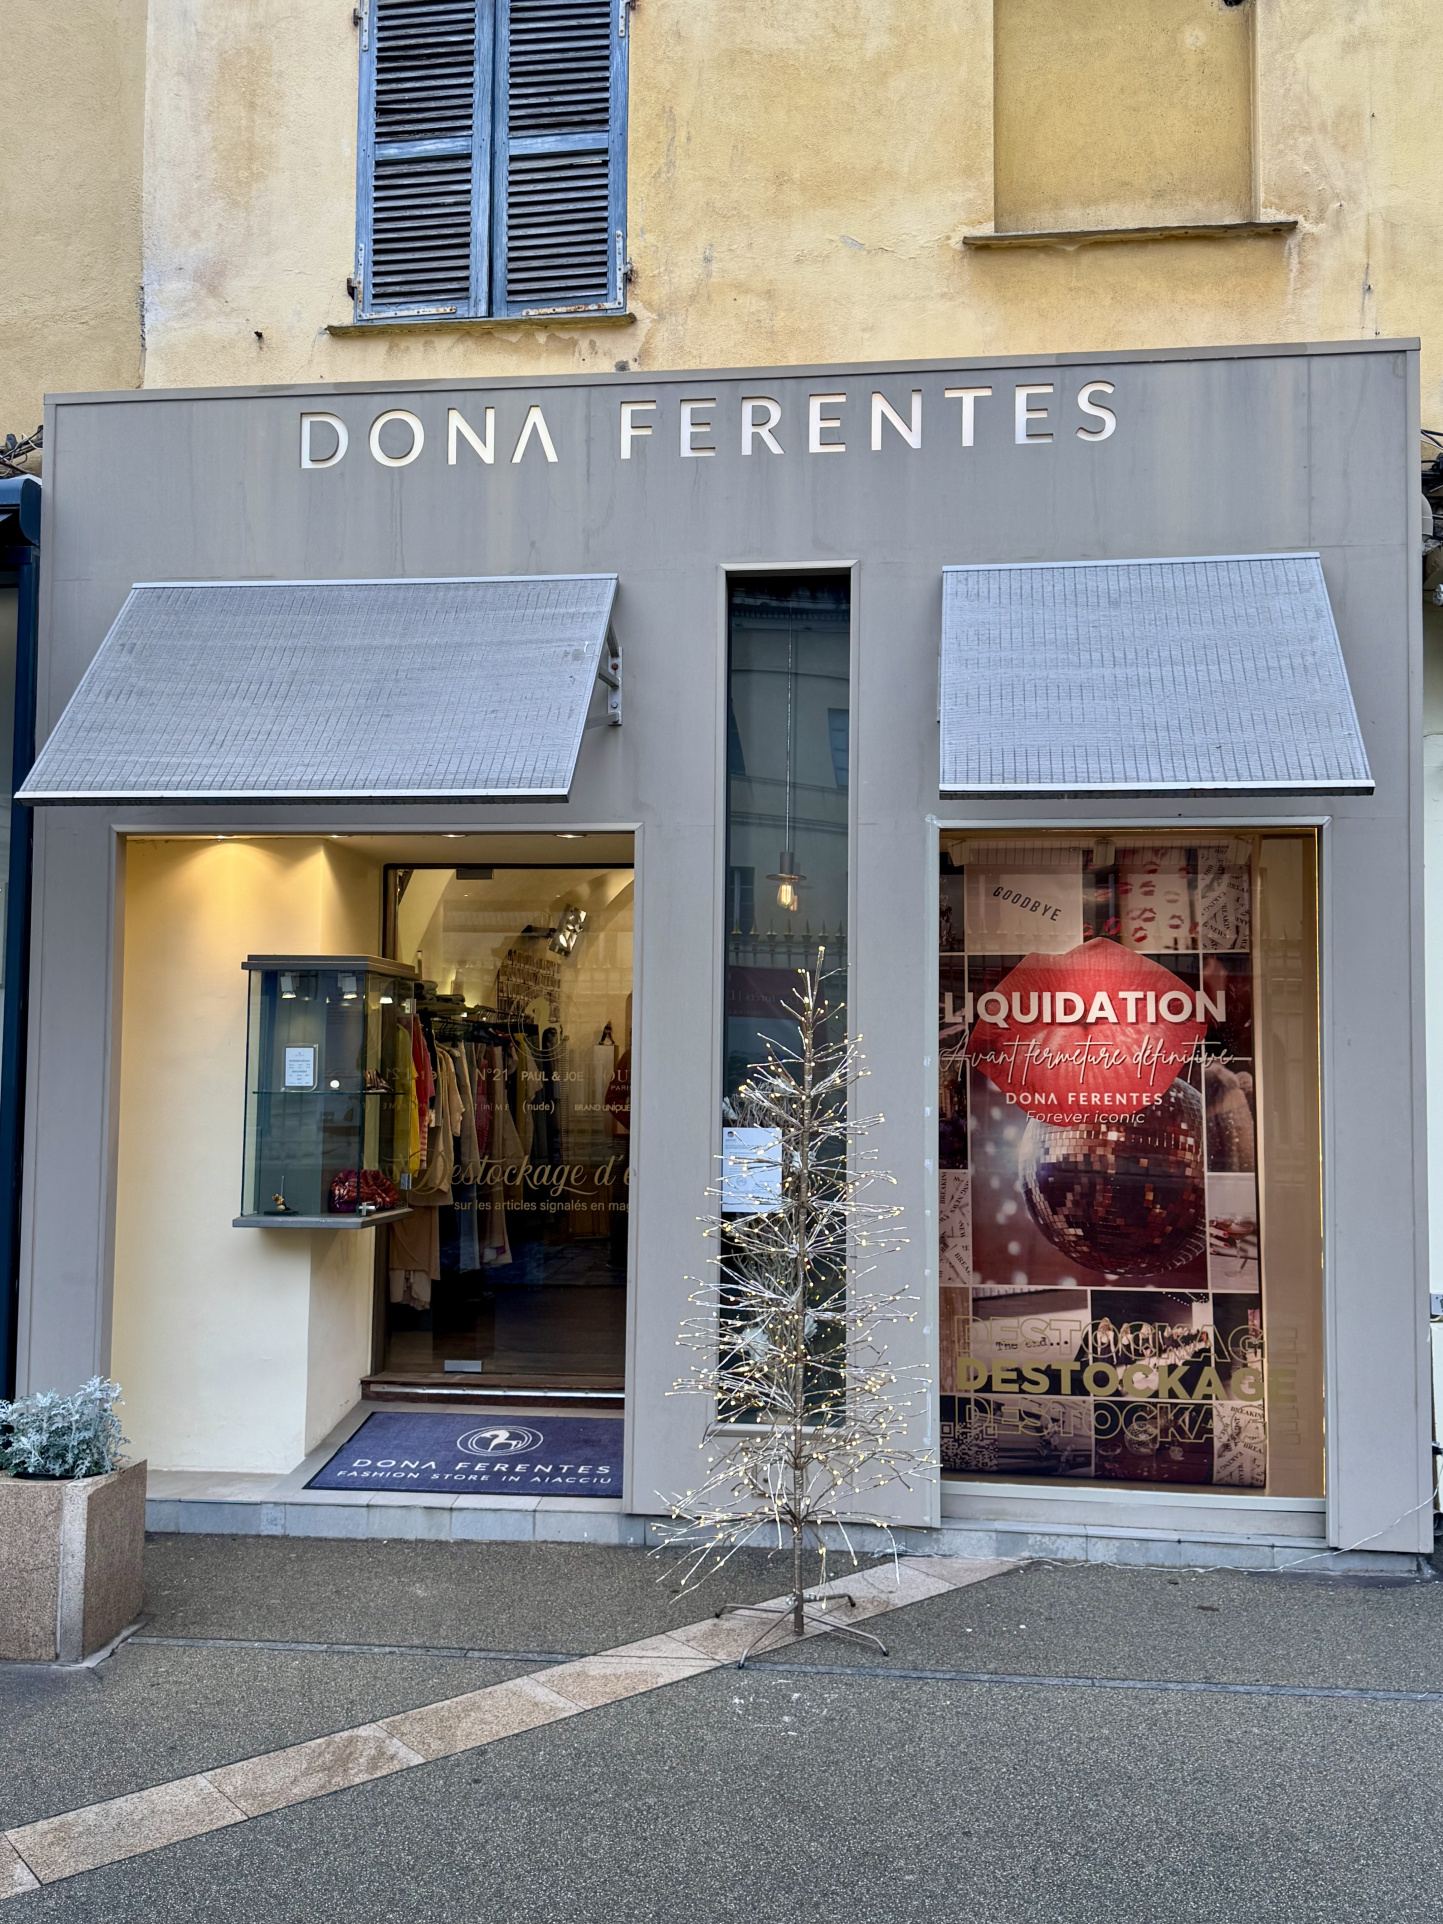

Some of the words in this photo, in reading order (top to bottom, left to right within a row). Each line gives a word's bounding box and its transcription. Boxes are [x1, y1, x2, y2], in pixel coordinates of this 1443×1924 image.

[300, 404, 559, 469] DONA
[620, 382, 1118, 460] FERENTES
[992, 886, 1062, 921] GOODBYE
[944, 990, 1226, 1029] LIQUIDATION
[938, 1026, 1042, 1084] Avant
[1024, 1035, 1127, 1085] fermeture
[521, 1071, 548, 1081] PAUL
[551, 1071, 561, 1081] &
[565, 1071, 584, 1081] JOE
[1005, 1092, 1058, 1105] DONA
[1068, 1092, 1163, 1105] FERENTES
[522, 1101, 555, 1114] (nude)
[574, 1104, 601, 1112] BRAND
[1026, 1110, 1090, 1123] Forever
[1094, 1110, 1146, 1123] iconic
[411, 1149, 598, 1197] Destockage
[454, 1201, 471, 1211] sur
[475, 1200, 492, 1211] les
[494, 1200, 537, 1211] articles
[540, 1200, 588, 1214] signalés
[590, 1202, 605, 1211] en
[956, 1357, 1298, 1403] DESTOCKAGE
[352, 1459, 436, 1469] DONA
[455, 1462, 611, 1474] FERENTES
[337, 1470, 420, 1479] FASHION
[430, 1473, 491, 1481] STORE
[530, 1476, 612, 1484] AIACCIU
